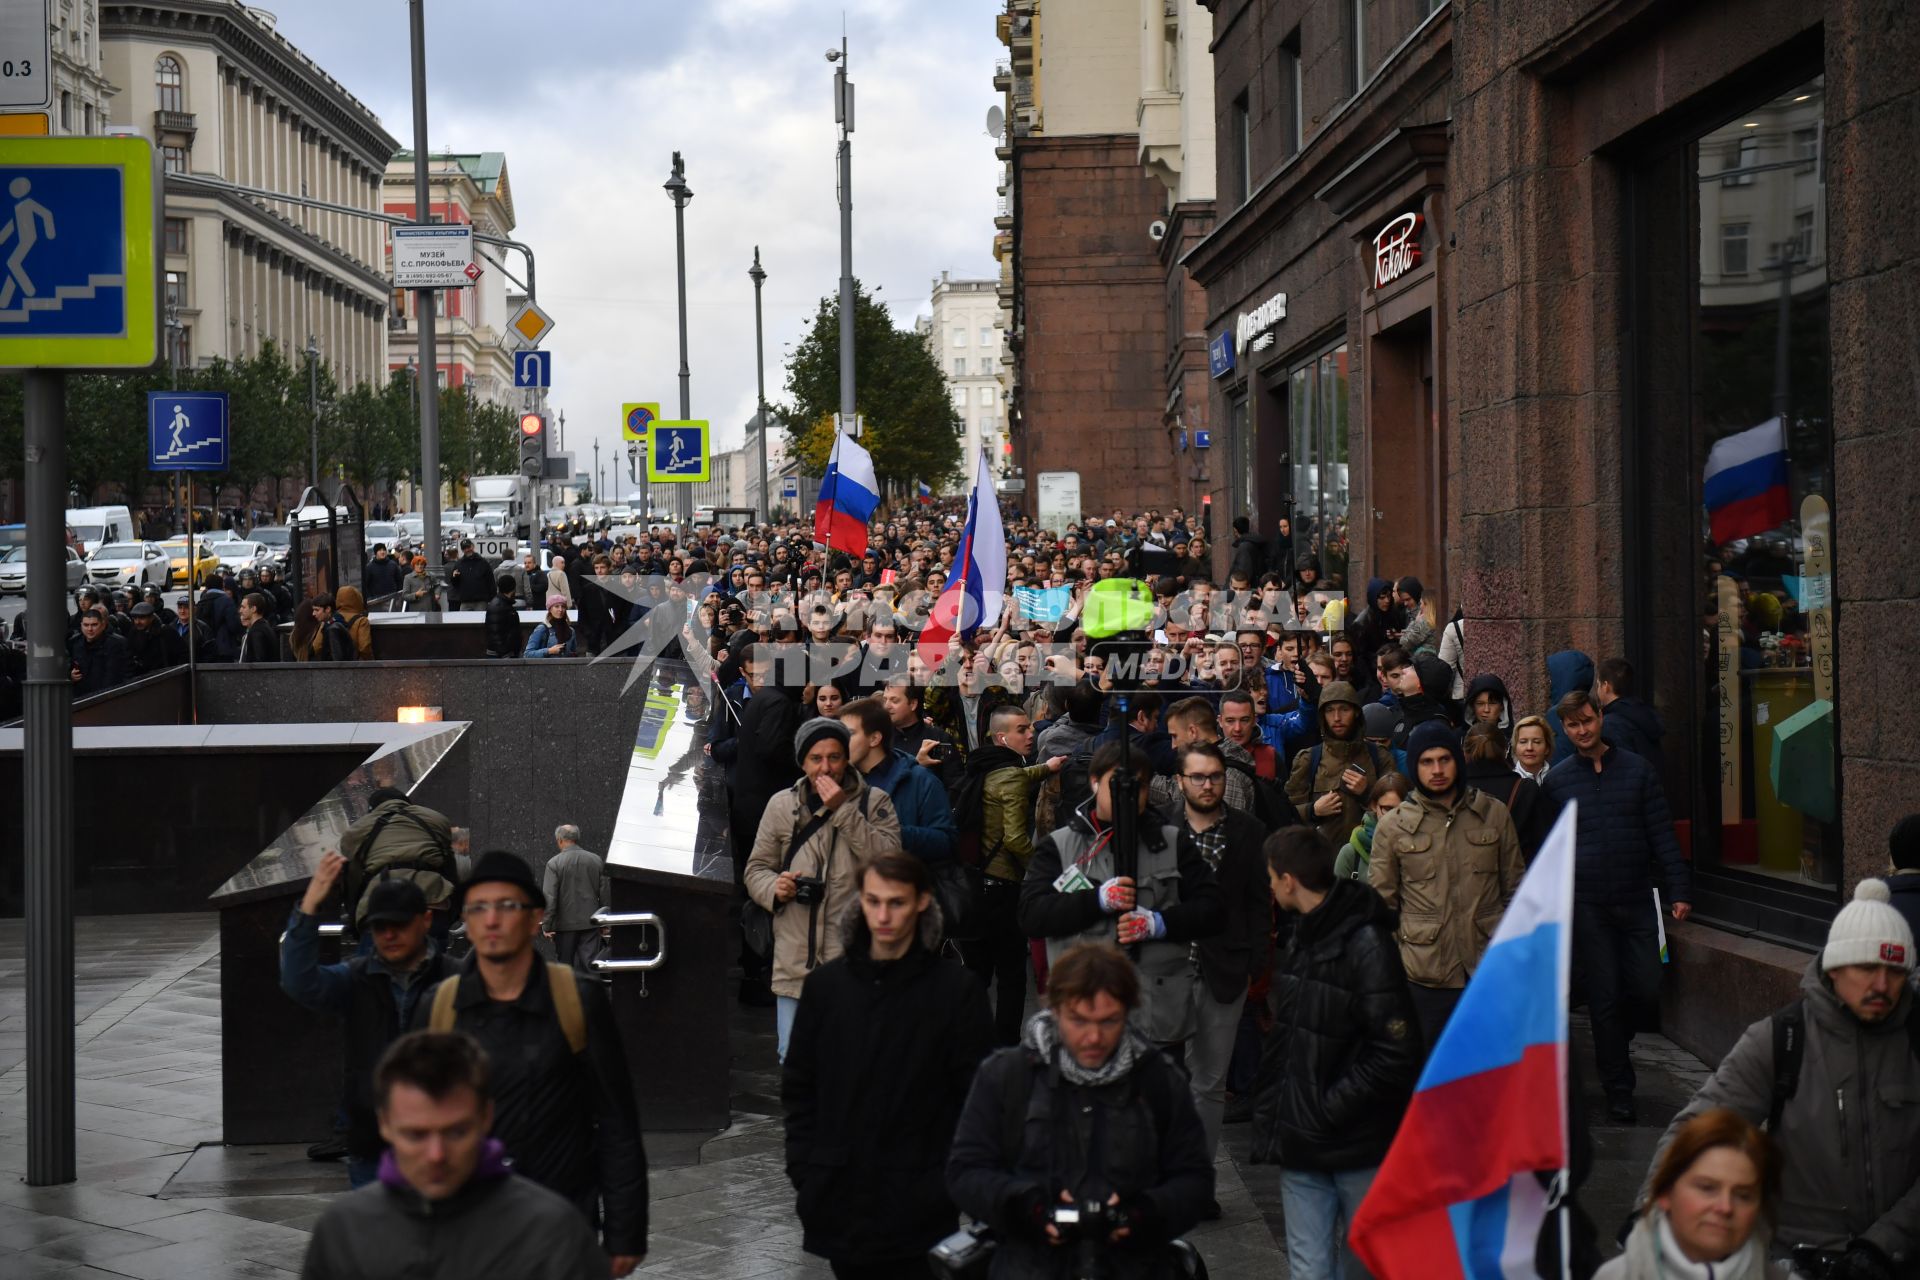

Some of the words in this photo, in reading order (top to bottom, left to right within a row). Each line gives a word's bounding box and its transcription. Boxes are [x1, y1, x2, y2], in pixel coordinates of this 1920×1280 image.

[3, 60, 31, 77] 0.3
[420, 250, 445, 258] МУЗЕЙ
[1373, 212, 1417, 289] Raketa
[415, 259, 466, 267] ПРОКОФЬЕВА
[476, 541, 509, 555] ТОП
